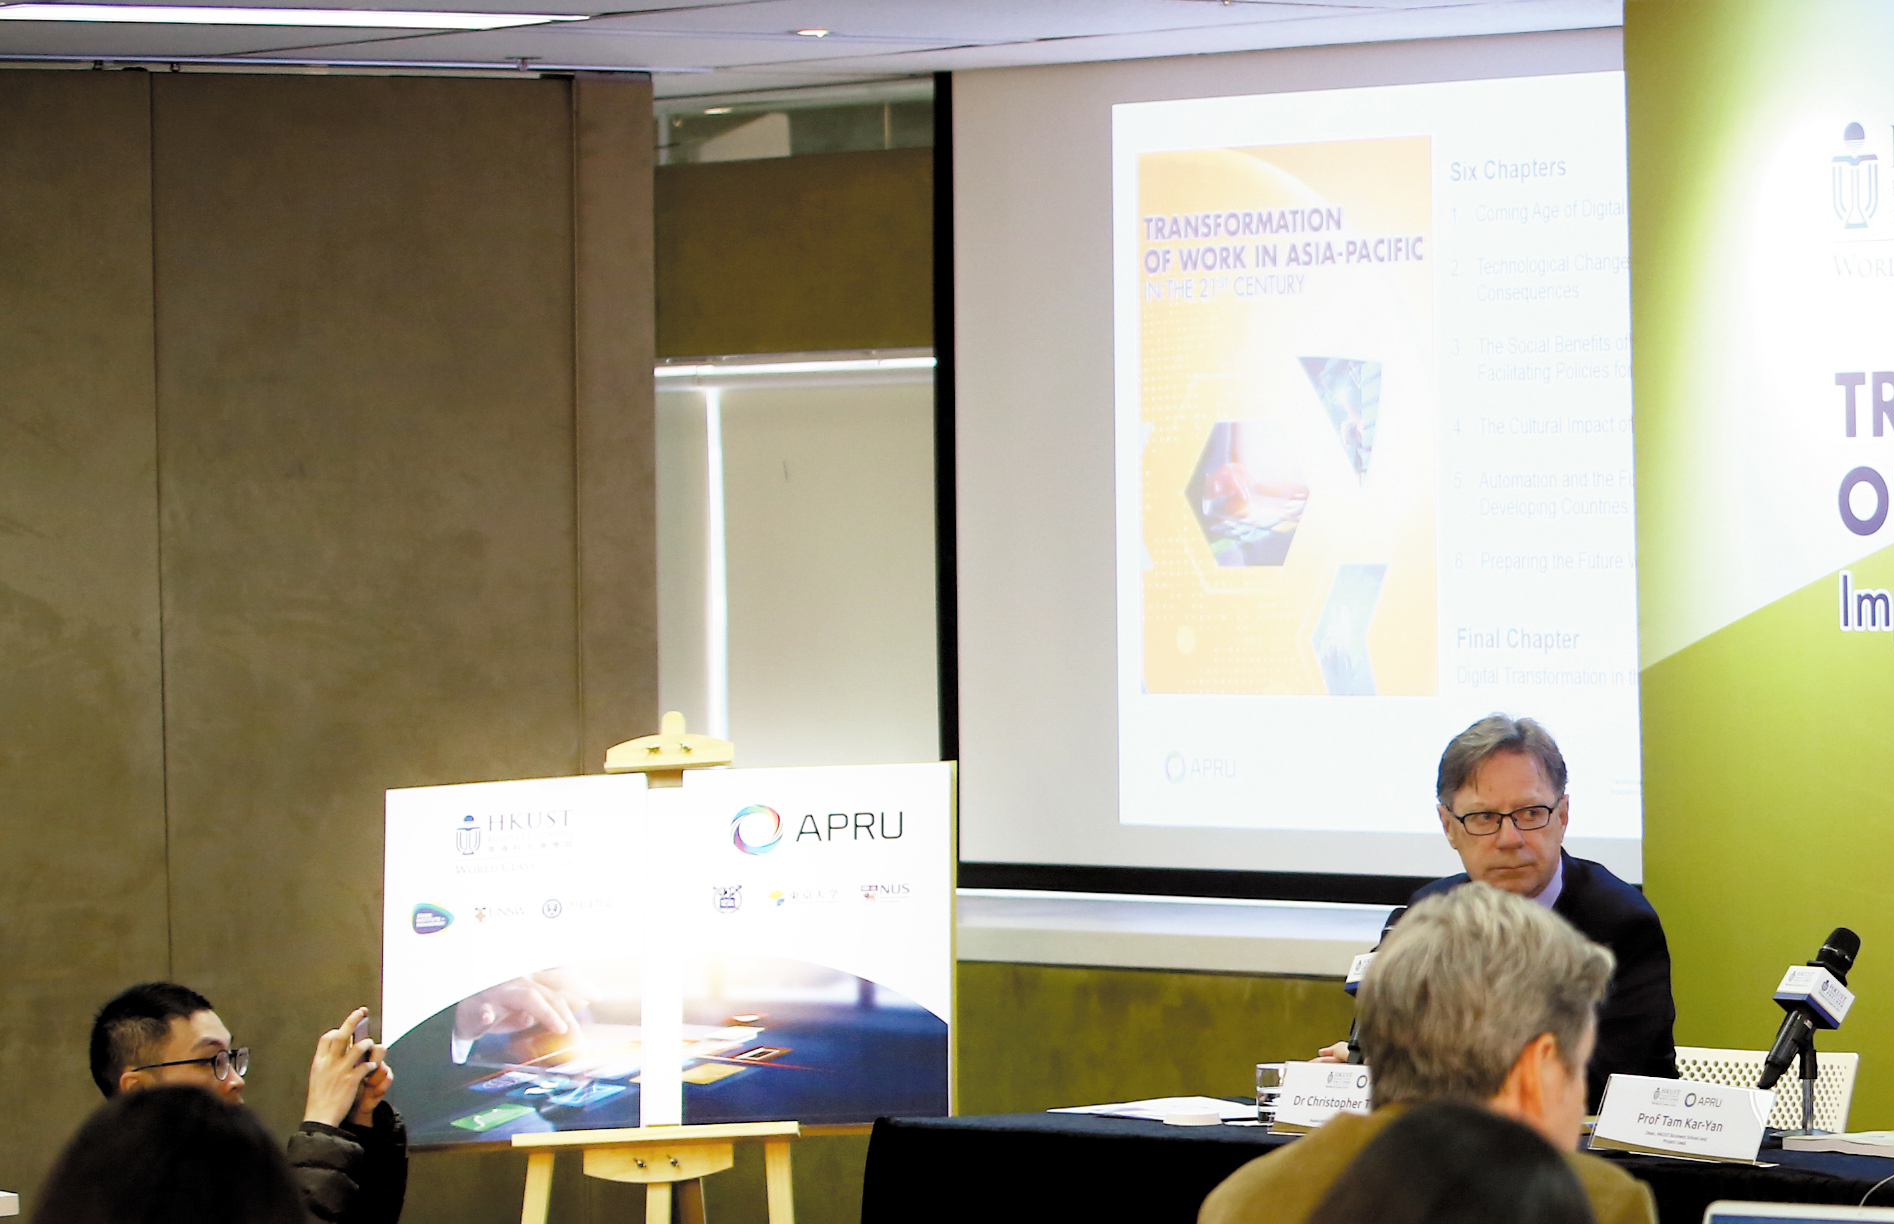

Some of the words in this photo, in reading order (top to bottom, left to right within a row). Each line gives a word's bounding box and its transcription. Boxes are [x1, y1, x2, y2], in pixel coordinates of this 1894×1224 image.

[1450, 161, 1477, 181] Six
[1484, 160, 1567, 184] Chapters
[1475, 204, 1528, 224] Coming
[1531, 202, 1559, 224] Age
[1564, 200, 1577, 218] of
[1582, 198, 1626, 221] Digital
[1142, 206, 1342, 240] TRANSFORMATION
[1143, 247, 1171, 274] OF
[1178, 245, 1246, 272] WORK
[1254, 243, 1277, 268] IN
[1285, 235, 1424, 267] ASIA-PACIFIC
[1477, 255, 1569, 277] Technological
[1144, 281, 1161, 301] IN
[1166, 279, 1193, 300] THE
[1233, 273, 1305, 297] CENTURY
[1477, 283, 1580, 304] Consequences
[1477, 337, 1504, 355] The
[1508, 335, 1550, 355] Social
[1554, 334, 1611, 353] Benefits
[1615, 333, 1630, 352] of
[1478, 364, 1551, 385] Facilitating
[1556, 362, 1609, 380] Policies
[1479, 417, 1505, 436] The
[1509, 416, 1562, 435] Cultural
[1566, 416, 1614, 437] Impact
[1479, 471, 1560, 490] Automation
[1562, 471, 1587, 489] and
[1592, 470, 1614, 488] the
[1480, 499, 1557, 519] Developing
[1561, 497, 1628, 516] Countries
[1481, 552, 1547, 573] Preparing
[1552, 552, 1574, 570] the
[1578, 552, 1623, 570] Future
[1457, 628, 1500, 649] Final
[1506, 628, 1580, 654] Chapter
[1457, 666, 1499, 688] Digital
[1503, 665, 1606, 686] Transformation
[1611, 667, 1624, 686] in
[1190, 758, 1236, 778] APRU
[488, 809, 574, 832] HKUST
[796, 811, 903, 842] APRU
[880, 883, 910, 894] NUS
[489, 906, 526, 917] UNSW
[1293, 1095, 1306, 1106] Dr
[1307, 1096, 1362, 1110] Christopher
[1698, 1096, 1723, 1108] APRU
[1637, 1112, 1660, 1125] Prof
[1663, 1115, 1682, 1128] Tam
[1685, 1118, 1723, 1132] Kar-Yan
